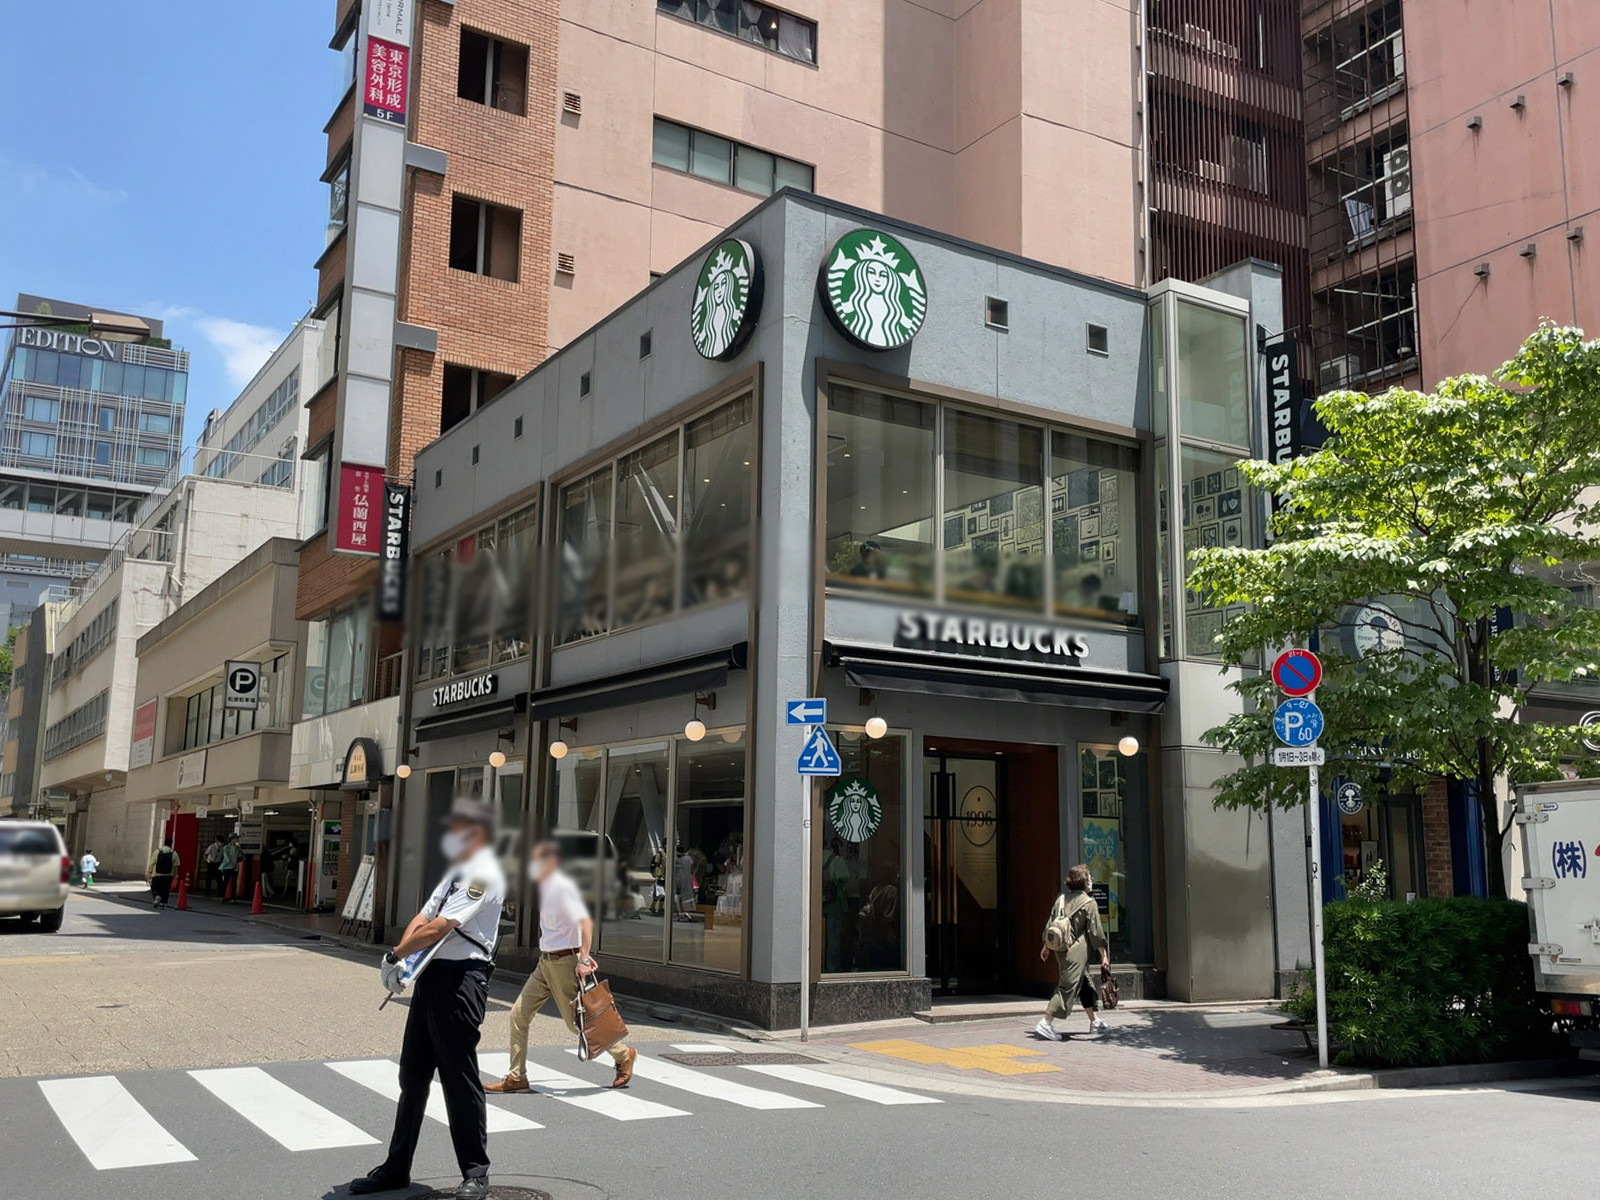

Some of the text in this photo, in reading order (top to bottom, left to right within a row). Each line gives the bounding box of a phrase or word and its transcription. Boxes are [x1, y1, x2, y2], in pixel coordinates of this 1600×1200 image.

[396, 0, 404, 34] RMALE
[369, 43, 387, 104] 美容外科
[386, 48, 404, 109] 東京形成
[376, 108, 394, 120] 5F
[20, 327, 117, 359] EDITION
[901, 611, 1091, 658] STARBUCKS
[234, 671, 254, 691] P
[432, 673, 492, 707] STARBUCKS
[1285, 711, 1304, 741] P
[1298, 727, 1313, 741] 60
